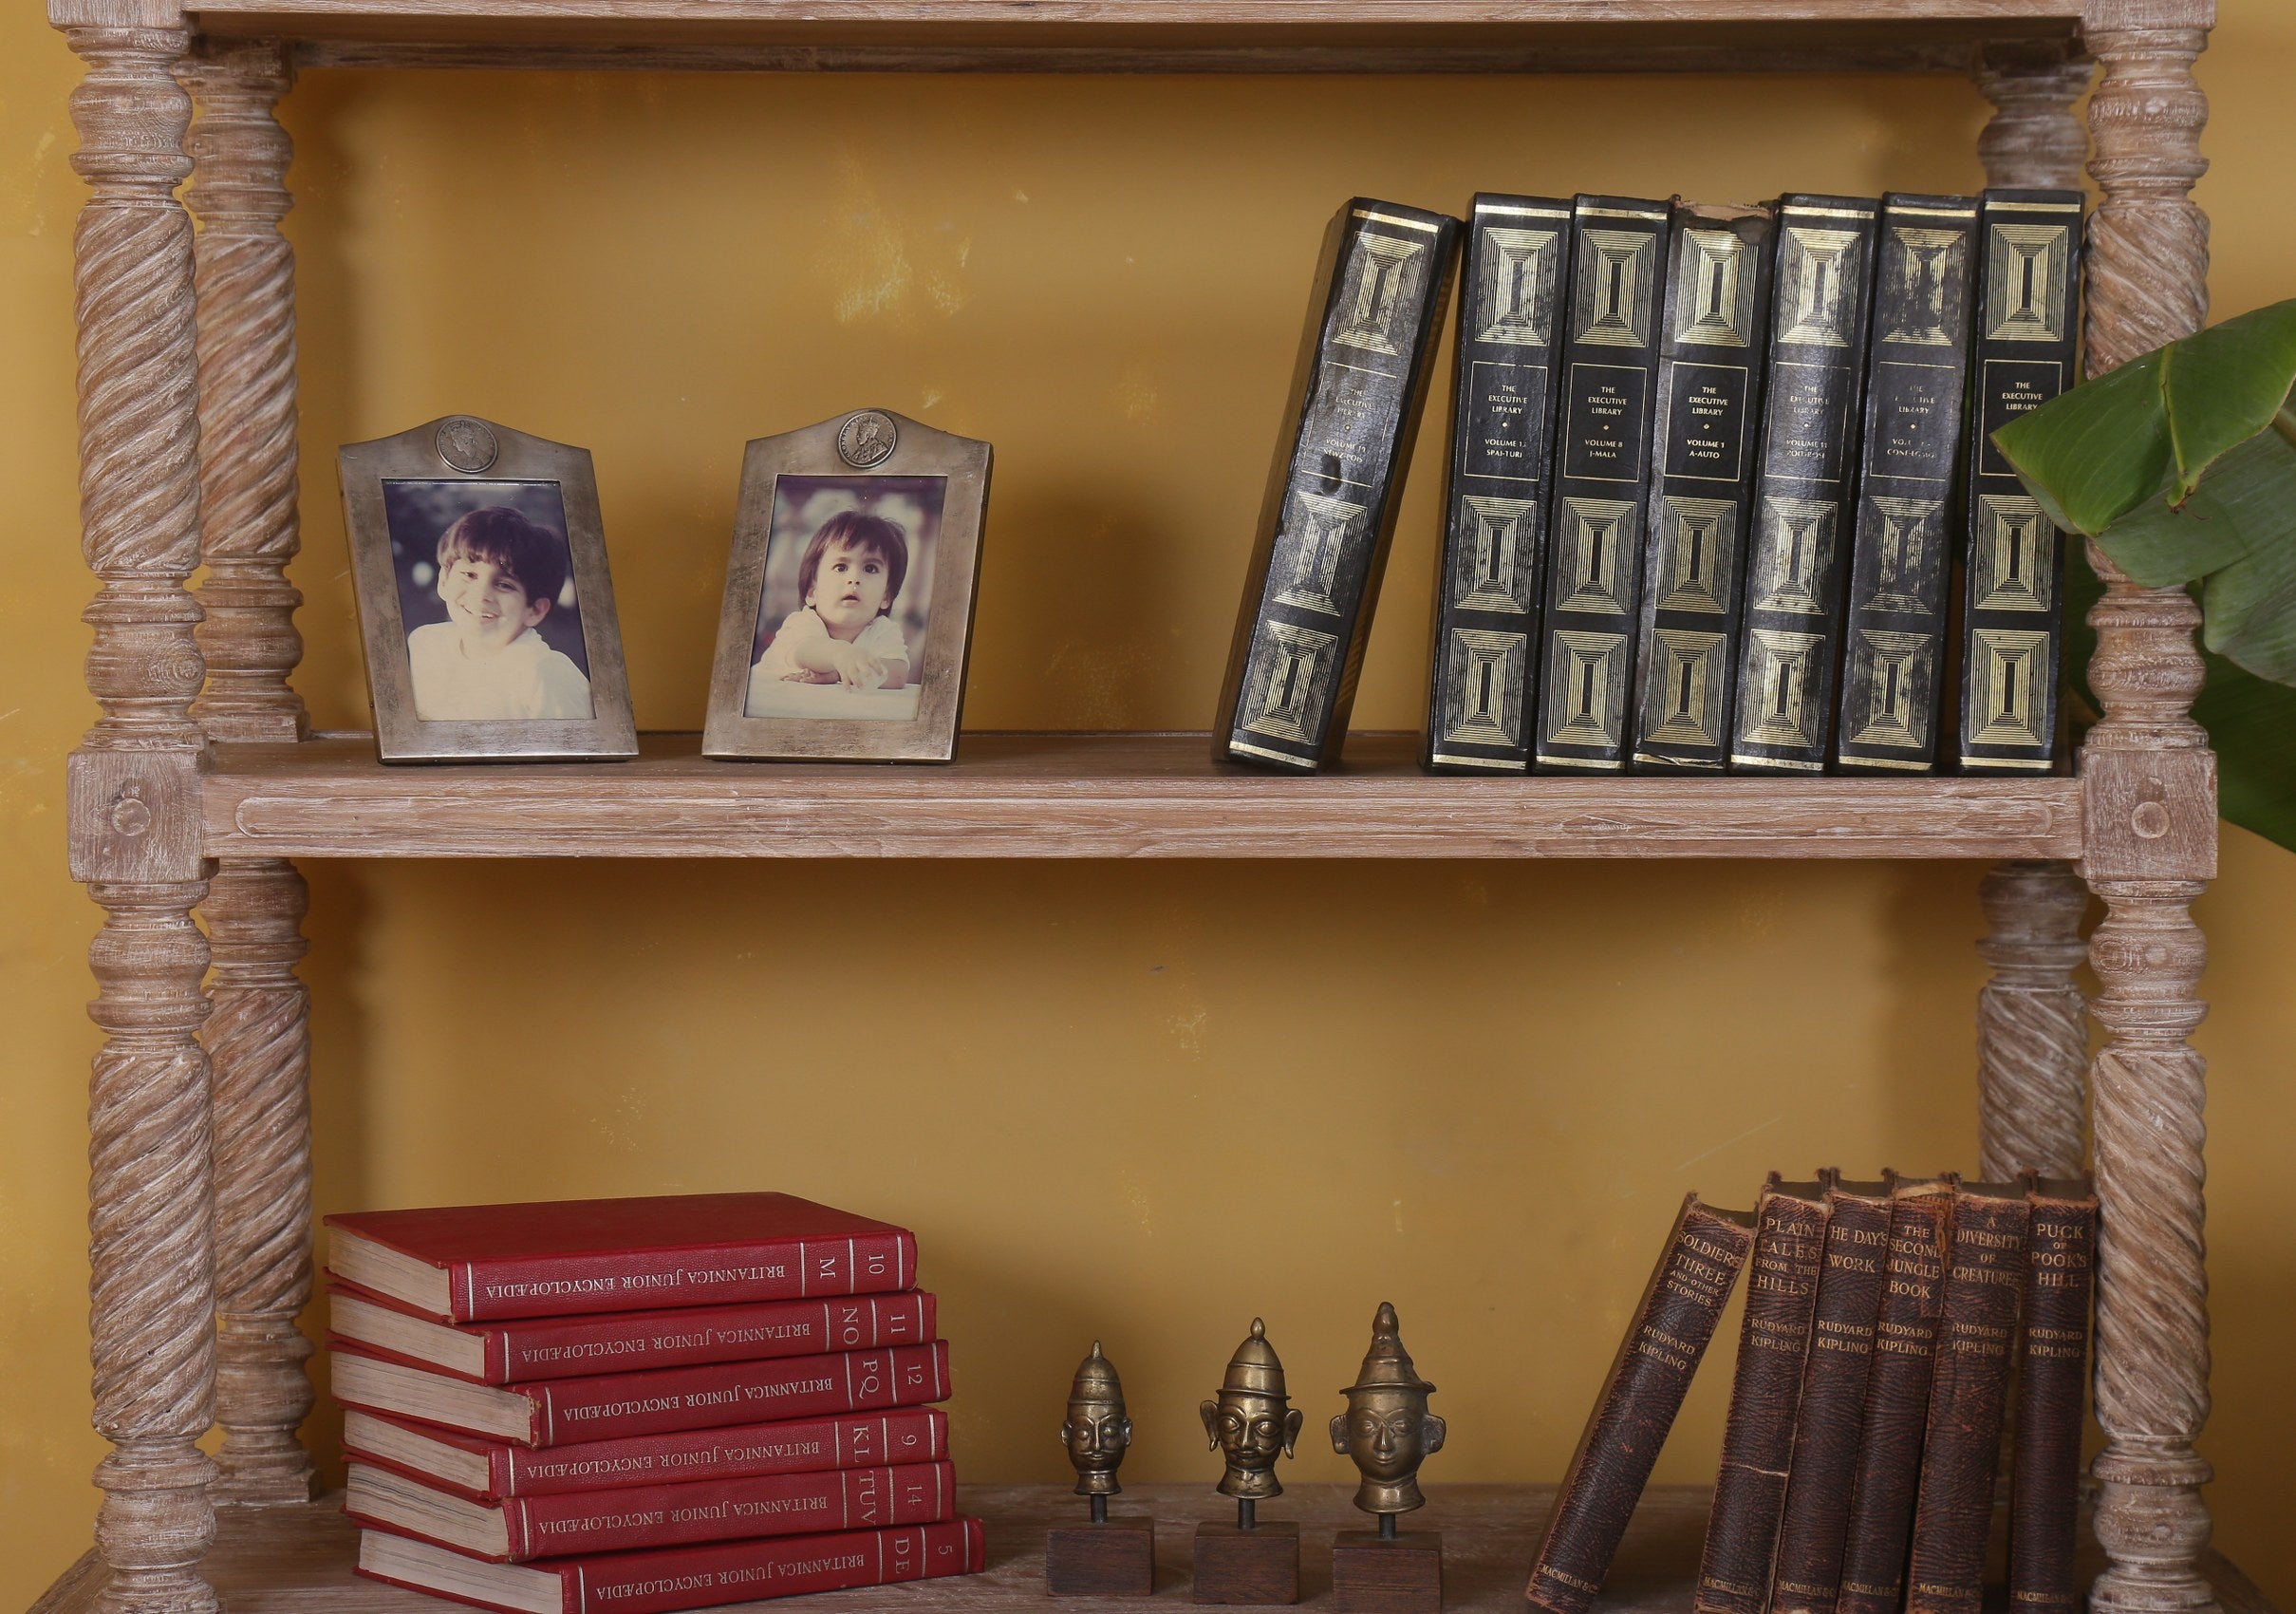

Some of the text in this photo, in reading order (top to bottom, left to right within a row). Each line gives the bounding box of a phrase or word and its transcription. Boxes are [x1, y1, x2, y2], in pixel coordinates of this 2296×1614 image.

[1488, 394, 1528, 404] EXECUTIVE
[1588, 396, 1627, 405] EXECUTIVE
[1689, 396, 1728, 406] EXECUTIVE
[2002, 392, 2043, 401] EXECUTIVE
[1492, 405, 1522, 414] LIBRARY
[1592, 407, 1622, 416] LIBRARY
[1691, 407, 1723, 416] LIBRARY
[1484, 438, 1517, 447] VOLUME
[1584, 439, 1615, 447] VOLUME
[1687, 439, 1719, 447] VOLUME
[1689, 450, 1720, 459] A-AUTO
[1765, 1216, 1815, 1237] PLAIN
[1987, 1216, 1997, 1227] A
[1830, 1225, 1888, 1247] HE DAY'S
[1904, 1225, 1931, 1238] THE
[2036, 1223, 2083, 1239] PUCK
[819, 1256, 836, 1279] M
[868, 1253, 885, 1275] 10
[1829, 1253, 1876, 1273] WORK
[1980, 1253, 1996, 1264] OF
[2031, 1250, 2087, 1268] POOK'S
[688, 1265, 785, 1284] BRITANNICA
[1673, 1253, 1726, 1286] THREE
[1795, 1263, 1817, 1276] THE
[1887, 1258, 1940, 1279] JUNGLE
[621, 1268, 683, 1289] JUNIOR
[1670, 1270, 1719, 1296] AND OTHER
[1757, 1275, 1809, 1295] HILLS
[2038, 1271, 2080, 1287] HILL
[1667, 1280, 1712, 1306] STORIES
[1889, 1281, 1932, 1299] BOOK
[890, 1313, 905, 1334] 11
[1751, 1319, 1804, 1335] RUDYARD
[1818, 1320, 1873, 1337] RUDYARD
[1877, 1321, 1932, 1339] RUDYARD
[1952, 1323, 2007, 1339] RUDYARD
[651, 1329, 712, 1348] JUNIOR
[717, 1323, 810, 1343] BRITANNICA
[1644, 1324, 1695, 1355] RUDYARD
[2029, 1327, 2082, 1342] RUDYARD
[1751, 1336, 1801, 1352] KIPLING
[1818, 1337, 1869, 1354] KIPLING
[1876, 1339, 1928, 1356] KIPLING
[1952, 1340, 2006, 1356] KIPLING
[2029, 1343, 2080, 1358] KIPLING
[1638, 1342, 1687, 1370] KIPLING
[906, 1363, 923, 1385] 12
[684, 1385, 741, 1407] JUNIOR
[744, 1378, 833, 1398] BRITANNICA
[902, 1434, 917, 1446] 9
[659, 1446, 720, 1467] JUNIOR
[724, 1441, 820, 1461] BRITANNICA
[906, 1484, 923, 1506] 14
[670, 1500, 729, 1522] JUNIOR
[733, 1495, 828, 1516] BRITANNICA
[938, 1545, 953, 1555] 5
[718, 1561, 774, 1586] JUNIOR
[777, 1554, 864, 1578] BRITANNICA
